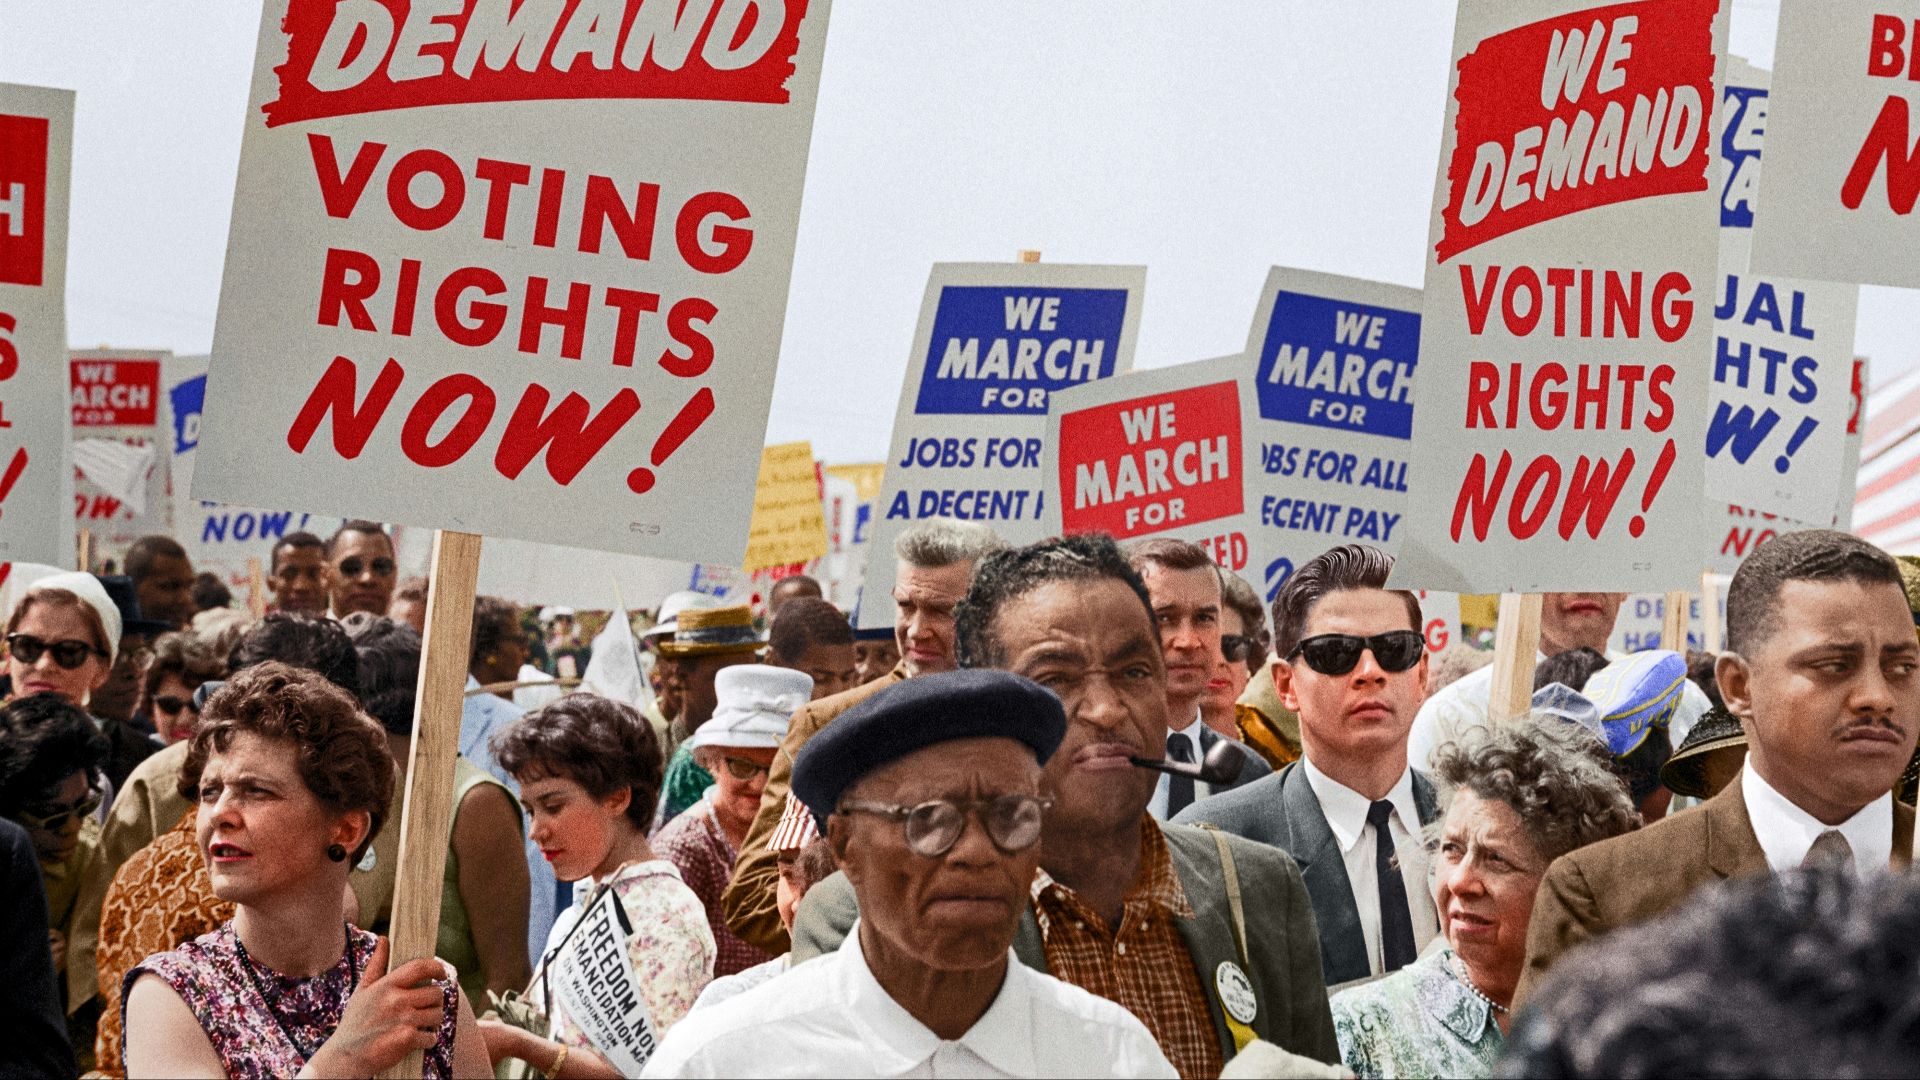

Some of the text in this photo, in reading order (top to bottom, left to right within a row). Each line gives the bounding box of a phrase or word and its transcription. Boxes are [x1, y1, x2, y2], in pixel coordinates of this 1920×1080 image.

[308, 0, 787, 93] DEMAND
[1540, 15, 1640, 111] WE
[1458, 84, 1703, 228] DEMAND
[306, 132, 755, 275] VOTING
[316, 247, 720, 378] RIGHTS
[1004, 295, 1061, 332] WE
[1335, 310, 1387, 351] WE
[1458, 263, 1695, 344] VOTING
[77, 364, 116, 383] WE
[936, 336, 1105, 381] MARCH
[1267, 342, 1420, 406] MARCH
[286, 355, 716, 495] NOW!
[981, 387, 1046, 409] FOR
[1119, 402, 1178, 445] WE
[1307, 398, 1368, 426] FOR
[1465, 361, 1677, 434] RIGHTS
[899, 437, 1042, 469] JOBS FOR
[1074, 434, 1230, 511] MARCH
[1303, 449, 1359, 484] FOR
[1360, 457, 1408, 493] ALL
[886, 490, 911, 520] A
[916, 490, 1030, 520] DECENT
[1125, 498, 1187, 531] FOR
[1450, 438, 1677, 544] NOW!
[1343, 507, 1402, 542] PAY
[571, 929, 635, 1048] EMANCIPATION
[586, 900, 638, 1017] FREEDOM
[572, 979, 619, 1048] WASHINGTON
